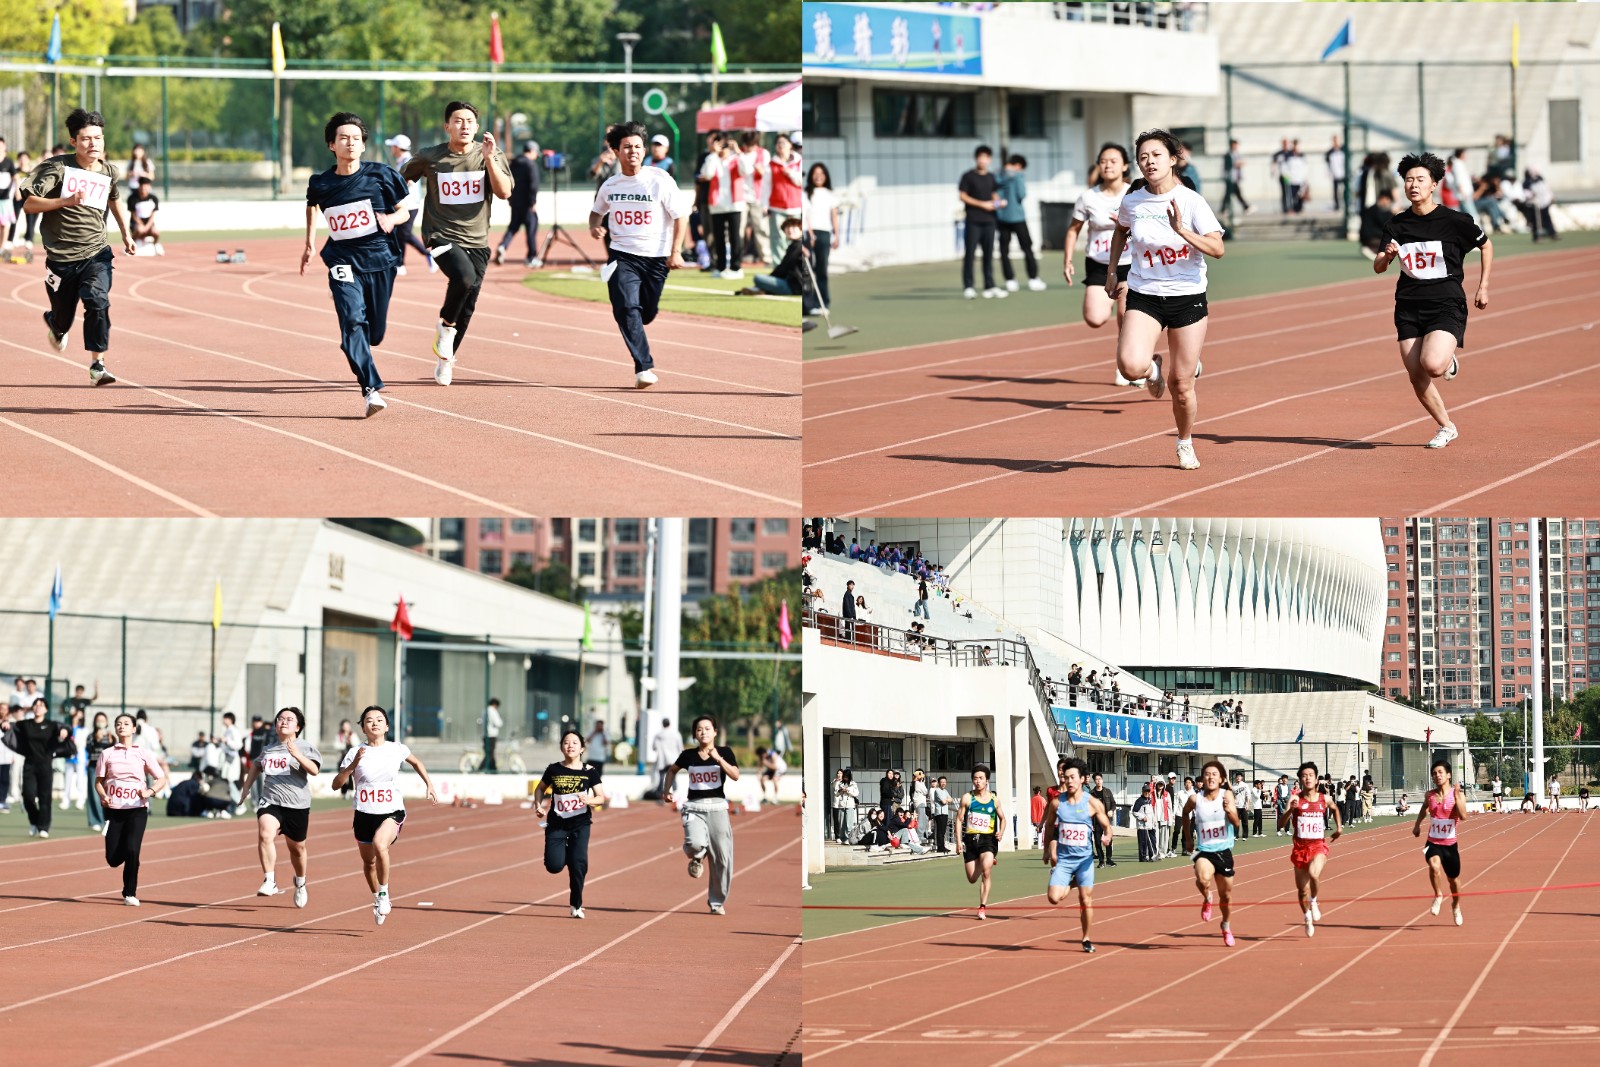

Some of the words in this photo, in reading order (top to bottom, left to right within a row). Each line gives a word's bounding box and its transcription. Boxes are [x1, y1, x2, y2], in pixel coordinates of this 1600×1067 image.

[67, 177, 106, 200] 0377
[442, 180, 480, 196] 0315
[329, 210, 370, 231] 0223
[615, 210, 652, 225] 0585
[1143, 244, 1189, 267] 1194
[1402, 252, 1436, 270] 157
[336, 266, 346, 279] 5
[690, 771, 718, 784] 0305
[109, 785, 138, 799] 0650
[360, 789, 393, 803] 0153
[1061, 829, 1086, 841] 1225
[1201, 826, 1226, 839] 1181
[1431, 823, 1453, 834] 1147
